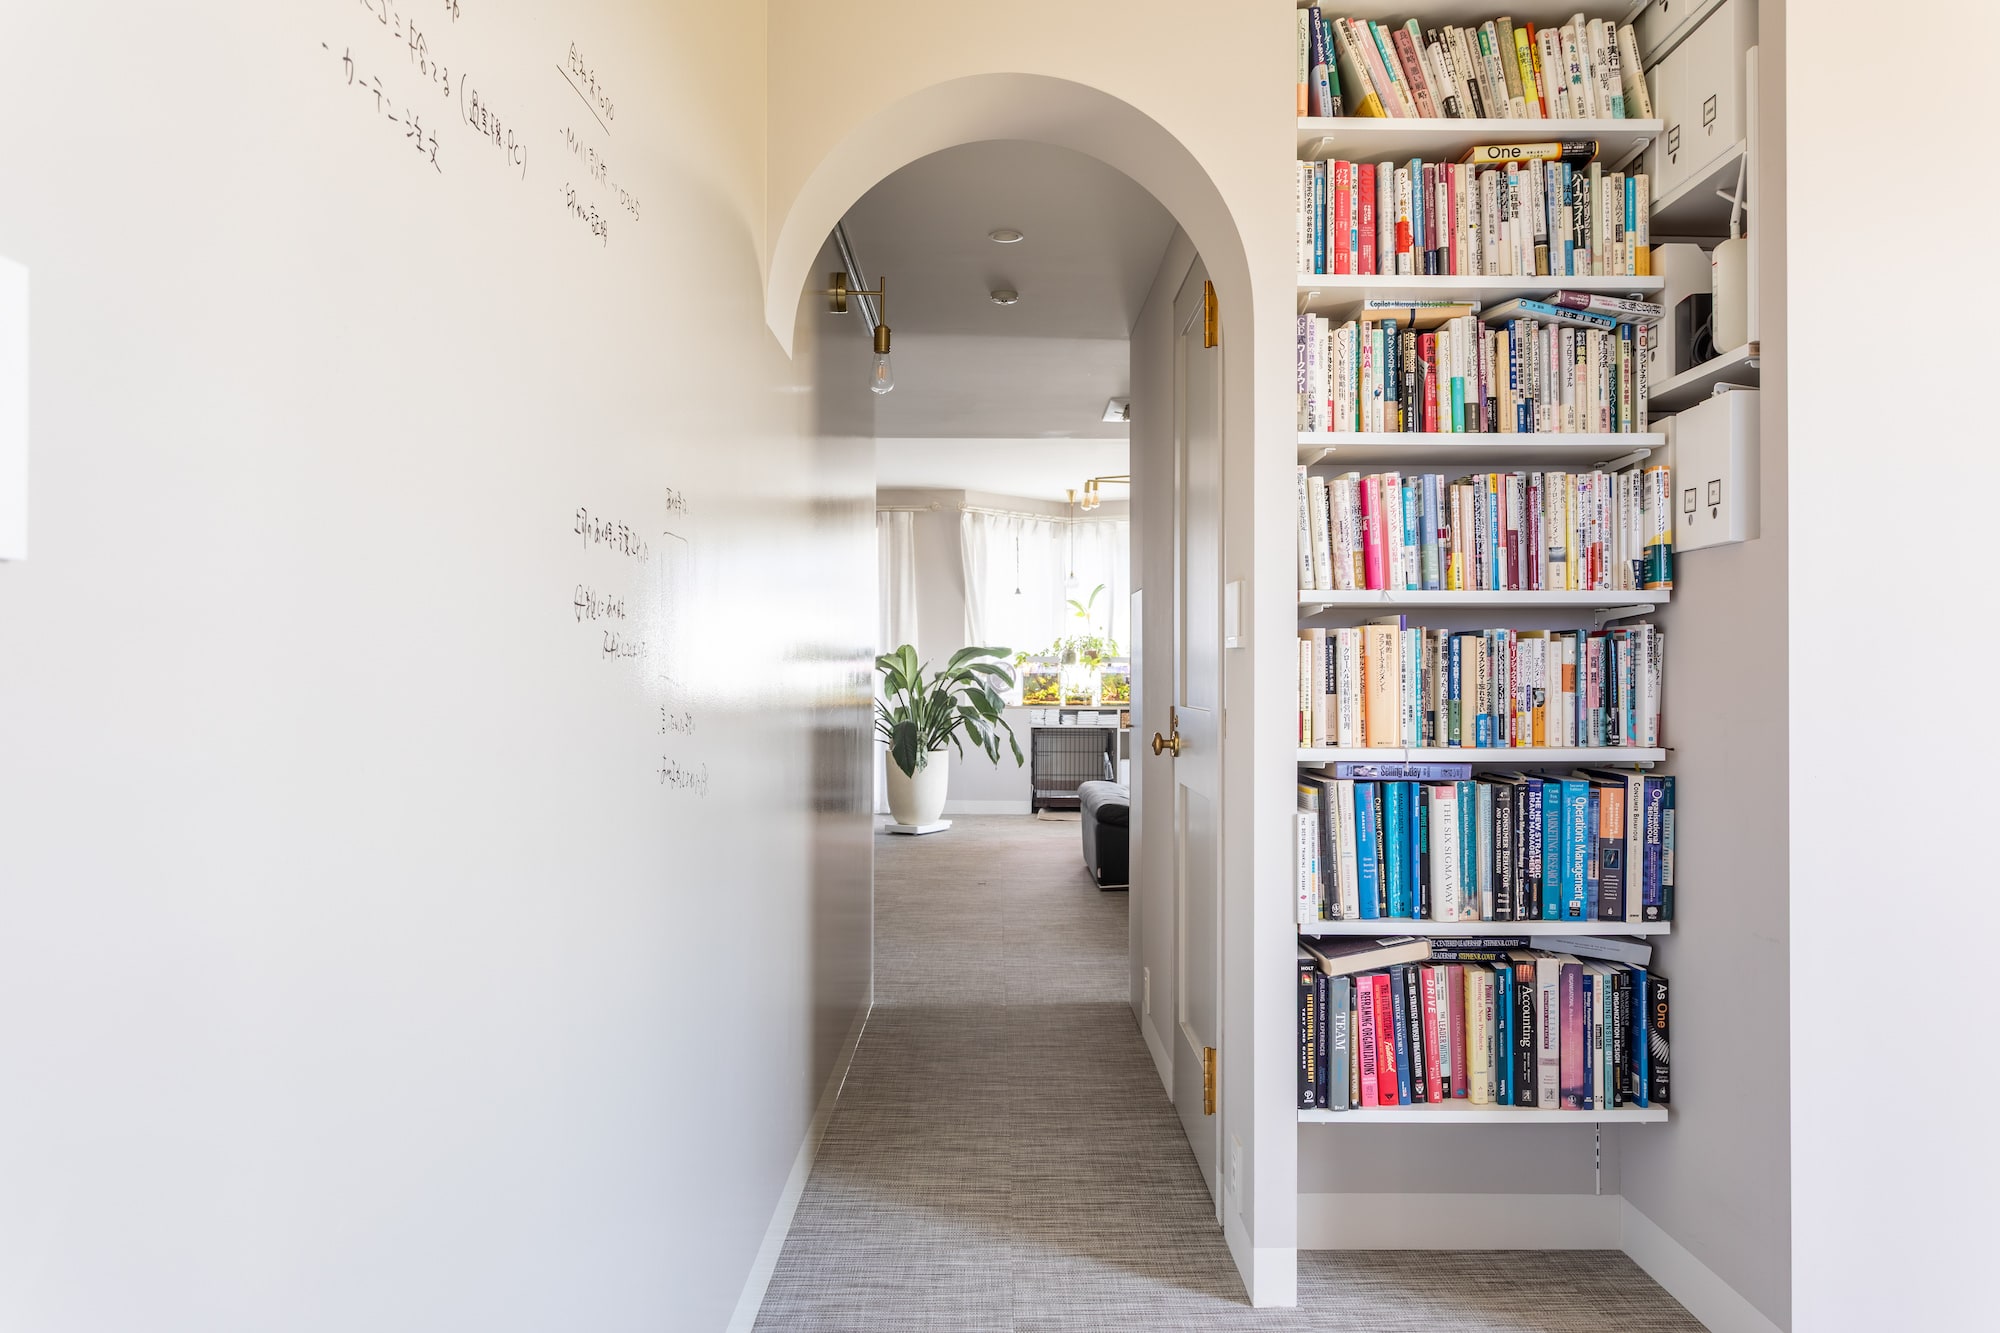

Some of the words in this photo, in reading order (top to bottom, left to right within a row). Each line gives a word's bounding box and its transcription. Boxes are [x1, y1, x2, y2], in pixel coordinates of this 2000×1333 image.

[1566, 33, 1582, 84] 考える技術
[1607, 25, 1620, 67] 経営は実行
[1597, 47, 1610, 91] 仮説思考
[1576, 96, 1586, 118] 大前研一
[1488, 146, 1521, 158] One
[1400, 172, 1408, 214] ダントツ経営
[1510, 186, 1519, 218] 工程管理
[1572, 173, 1585, 247] ハイフライヤー
[1614, 176, 1622, 223] 組織力を高める
[1370, 300, 1390, 308] Copilot
[1426, 336, 1436, 374] 小売再生
[1600, 334, 1608, 368] 超トヨタ式
[1380, 766, 1402, 778] Selling
[1444, 802, 1452, 824] THE
[1632, 782, 1640, 812] CONSUMER
[1502, 808, 1510, 849] CONSUMER
[1546, 810, 1558, 851] MARKETING
[1572, 796, 1586, 842] Operations
[1652, 788, 1662, 844] Organisational
[1444, 846, 1452, 880] SIGMA
[1502, 850, 1510, 888] BEHAVIOR
[1548, 852, 1558, 886] RESEARCH
[1572, 844, 1585, 900] Management
[1361, 992, 1371, 1026] REFRAMING
[1381, 994, 1390, 1010] FIFTH
[1426, 980, 1436, 1014] DRIVE
[1657, 984, 1667, 1000] As
[1335, 1012, 1346, 1050] TEAM
[1382, 1012, 1392, 1040] DISCIPLINE
[1410, 995, 1419, 1041] STRATEGY-FOCUSED
[1520, 986, 1534, 1048] Accounting
[1544, 984, 1555, 1050] ADVERTISING
[1657, 1003, 1667, 1028] One
[1362, 1028, 1374, 1076] ORGANIZATIONS
[1384, 1041, 1396, 1072] Fieldbook
[1412, 1042, 1422, 1078] ORGANIZATION
